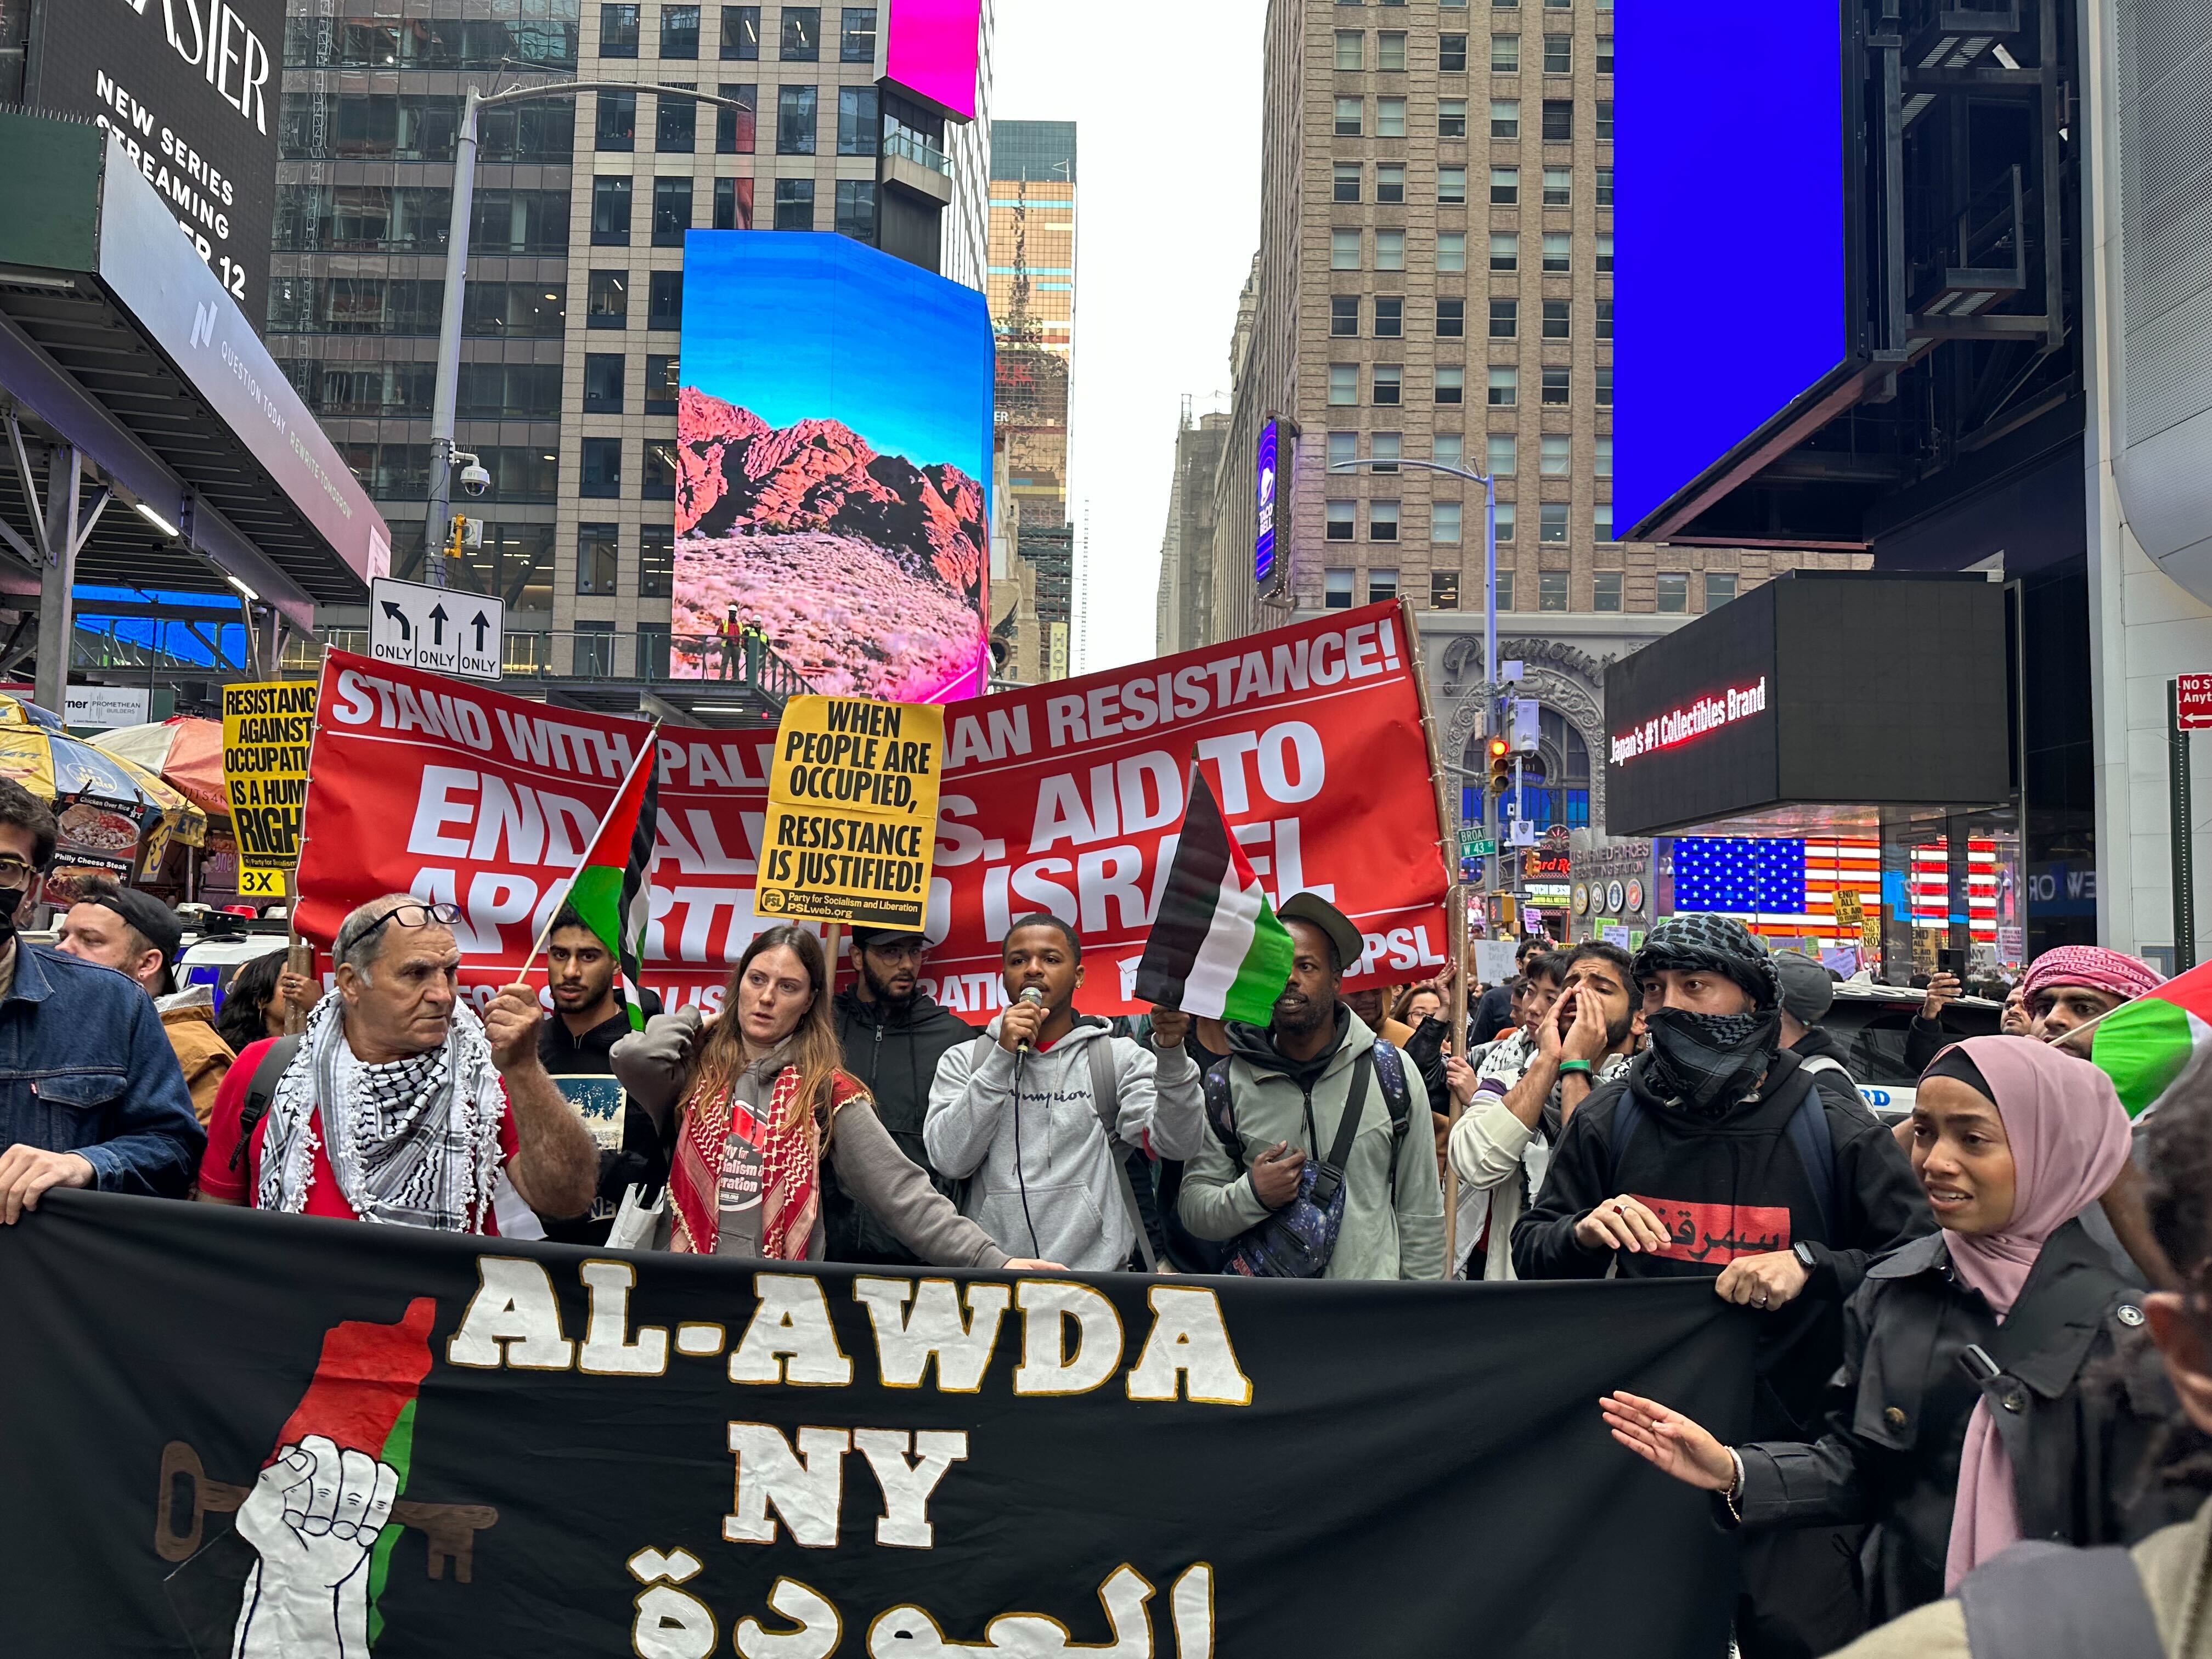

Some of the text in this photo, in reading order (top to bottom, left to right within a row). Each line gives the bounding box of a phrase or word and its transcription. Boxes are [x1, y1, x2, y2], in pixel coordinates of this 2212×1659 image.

[97, 69, 233, 206] NEW SERIES
[219, 256, 246, 301] 12
[221, 341, 353, 520] QUESTION TODAY REWRITE TOMORROW
[1259, 503, 1273, 522] TACO
[1260, 515, 1272, 537] BELL
[375, 644, 496, 673] ONLY ONLY ONLY
[1053, 633, 1064, 679] HOT
[1443, 636, 1616, 693] Pramount
[2182, 679, 2200, 690] NO
[2183, 691, 2212, 704] Anyt
[226, 687, 317, 716] RESISTANC
[332, 669, 493, 751] STAND
[496, 708, 634, 780] WITH
[1047, 618, 1401, 748] RESISTANCE!
[238, 716, 314, 744] AGAINST
[827, 701, 901, 738] WHEN
[1610, 676, 1765, 767] Japan's #1 Collectibles Brand
[225, 746, 310, 773] OCCUPATI
[785, 731, 877, 770] PEOPLE
[882, 741, 932, 774] ARE
[80, 797, 103, 806] Chicken
[230, 779, 306, 805] IS A HUM
[407, 764, 602, 868] END
[1026, 750, 1184, 854] AID
[1197, 721, 1325, 815] TO
[789, 765, 918, 814] OCCUPIED,
[129, 811, 143, 819] NY
[234, 807, 302, 854] RIGH
[778, 814, 922, 858] RESISTANCE
[1461, 828, 1486, 842] BROA
[55, 853, 127, 871] Philly Cheese Steak
[1464, 845, 1470, 856] W
[1474, 842, 1485, 854] 43
[242, 872, 273, 891] 3X
[767, 849, 923, 894] IS JUSTIFIED!
[764, 894, 782, 907] PSL
[788, 893, 918, 913] Party for Socialism and Liberation
[1838, 890, 1853, 899] END
[1841, 899, 1854, 907] ALL
[787, 902, 853, 919] PSLweb.org
[1342, 925, 1446, 978] PSL
[724, 1144, 749, 1159] rty for
[722, 1158, 758, 1177] ialism
[719, 1177, 758, 1193] eration
[445, 1255, 1252, 1406] AL-AWDA
[722, 1420, 968, 1549] NY
